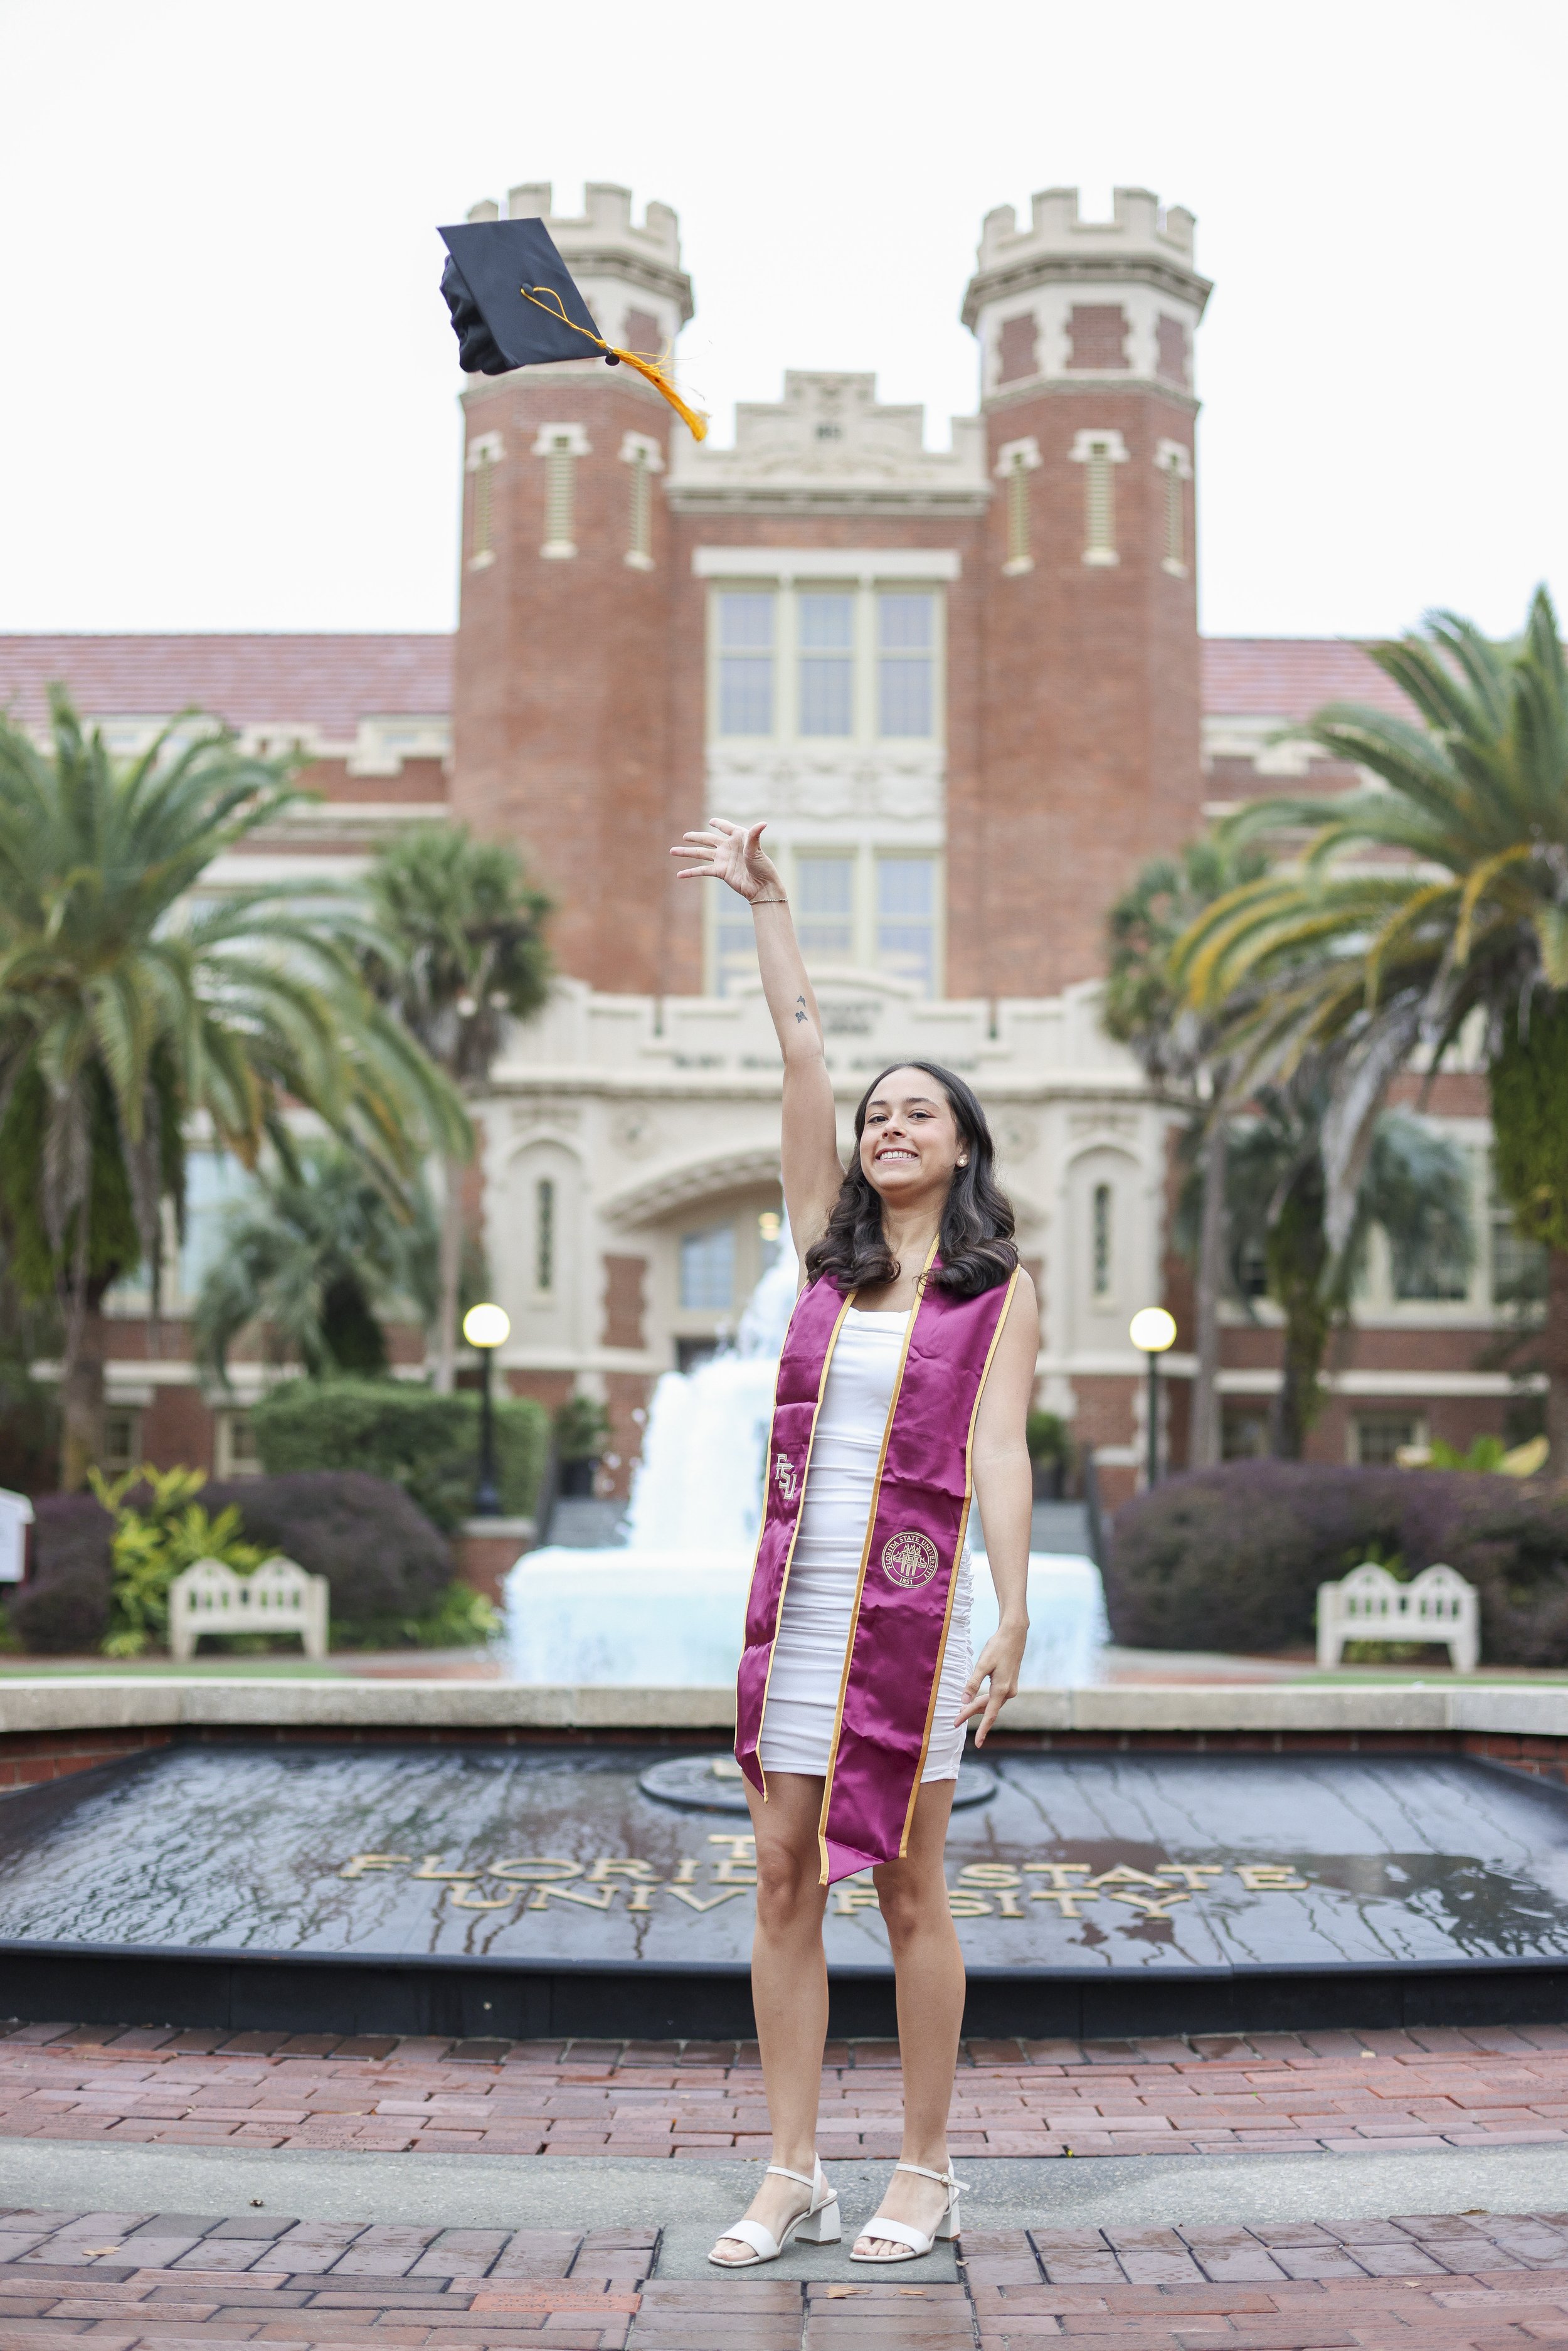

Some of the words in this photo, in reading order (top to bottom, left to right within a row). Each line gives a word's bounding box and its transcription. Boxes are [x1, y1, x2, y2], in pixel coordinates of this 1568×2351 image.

[775, 1453, 797, 1500] FSU
[885, 1540, 899, 1570] FLORIDA
[921, 1539, 936, 1579] UNIVERSITY
[899, 1577, 913, 1585] 1851
[957, 1862, 1309, 1891] STATE
[449, 1884, 1192, 1919] UNIVRSITY
